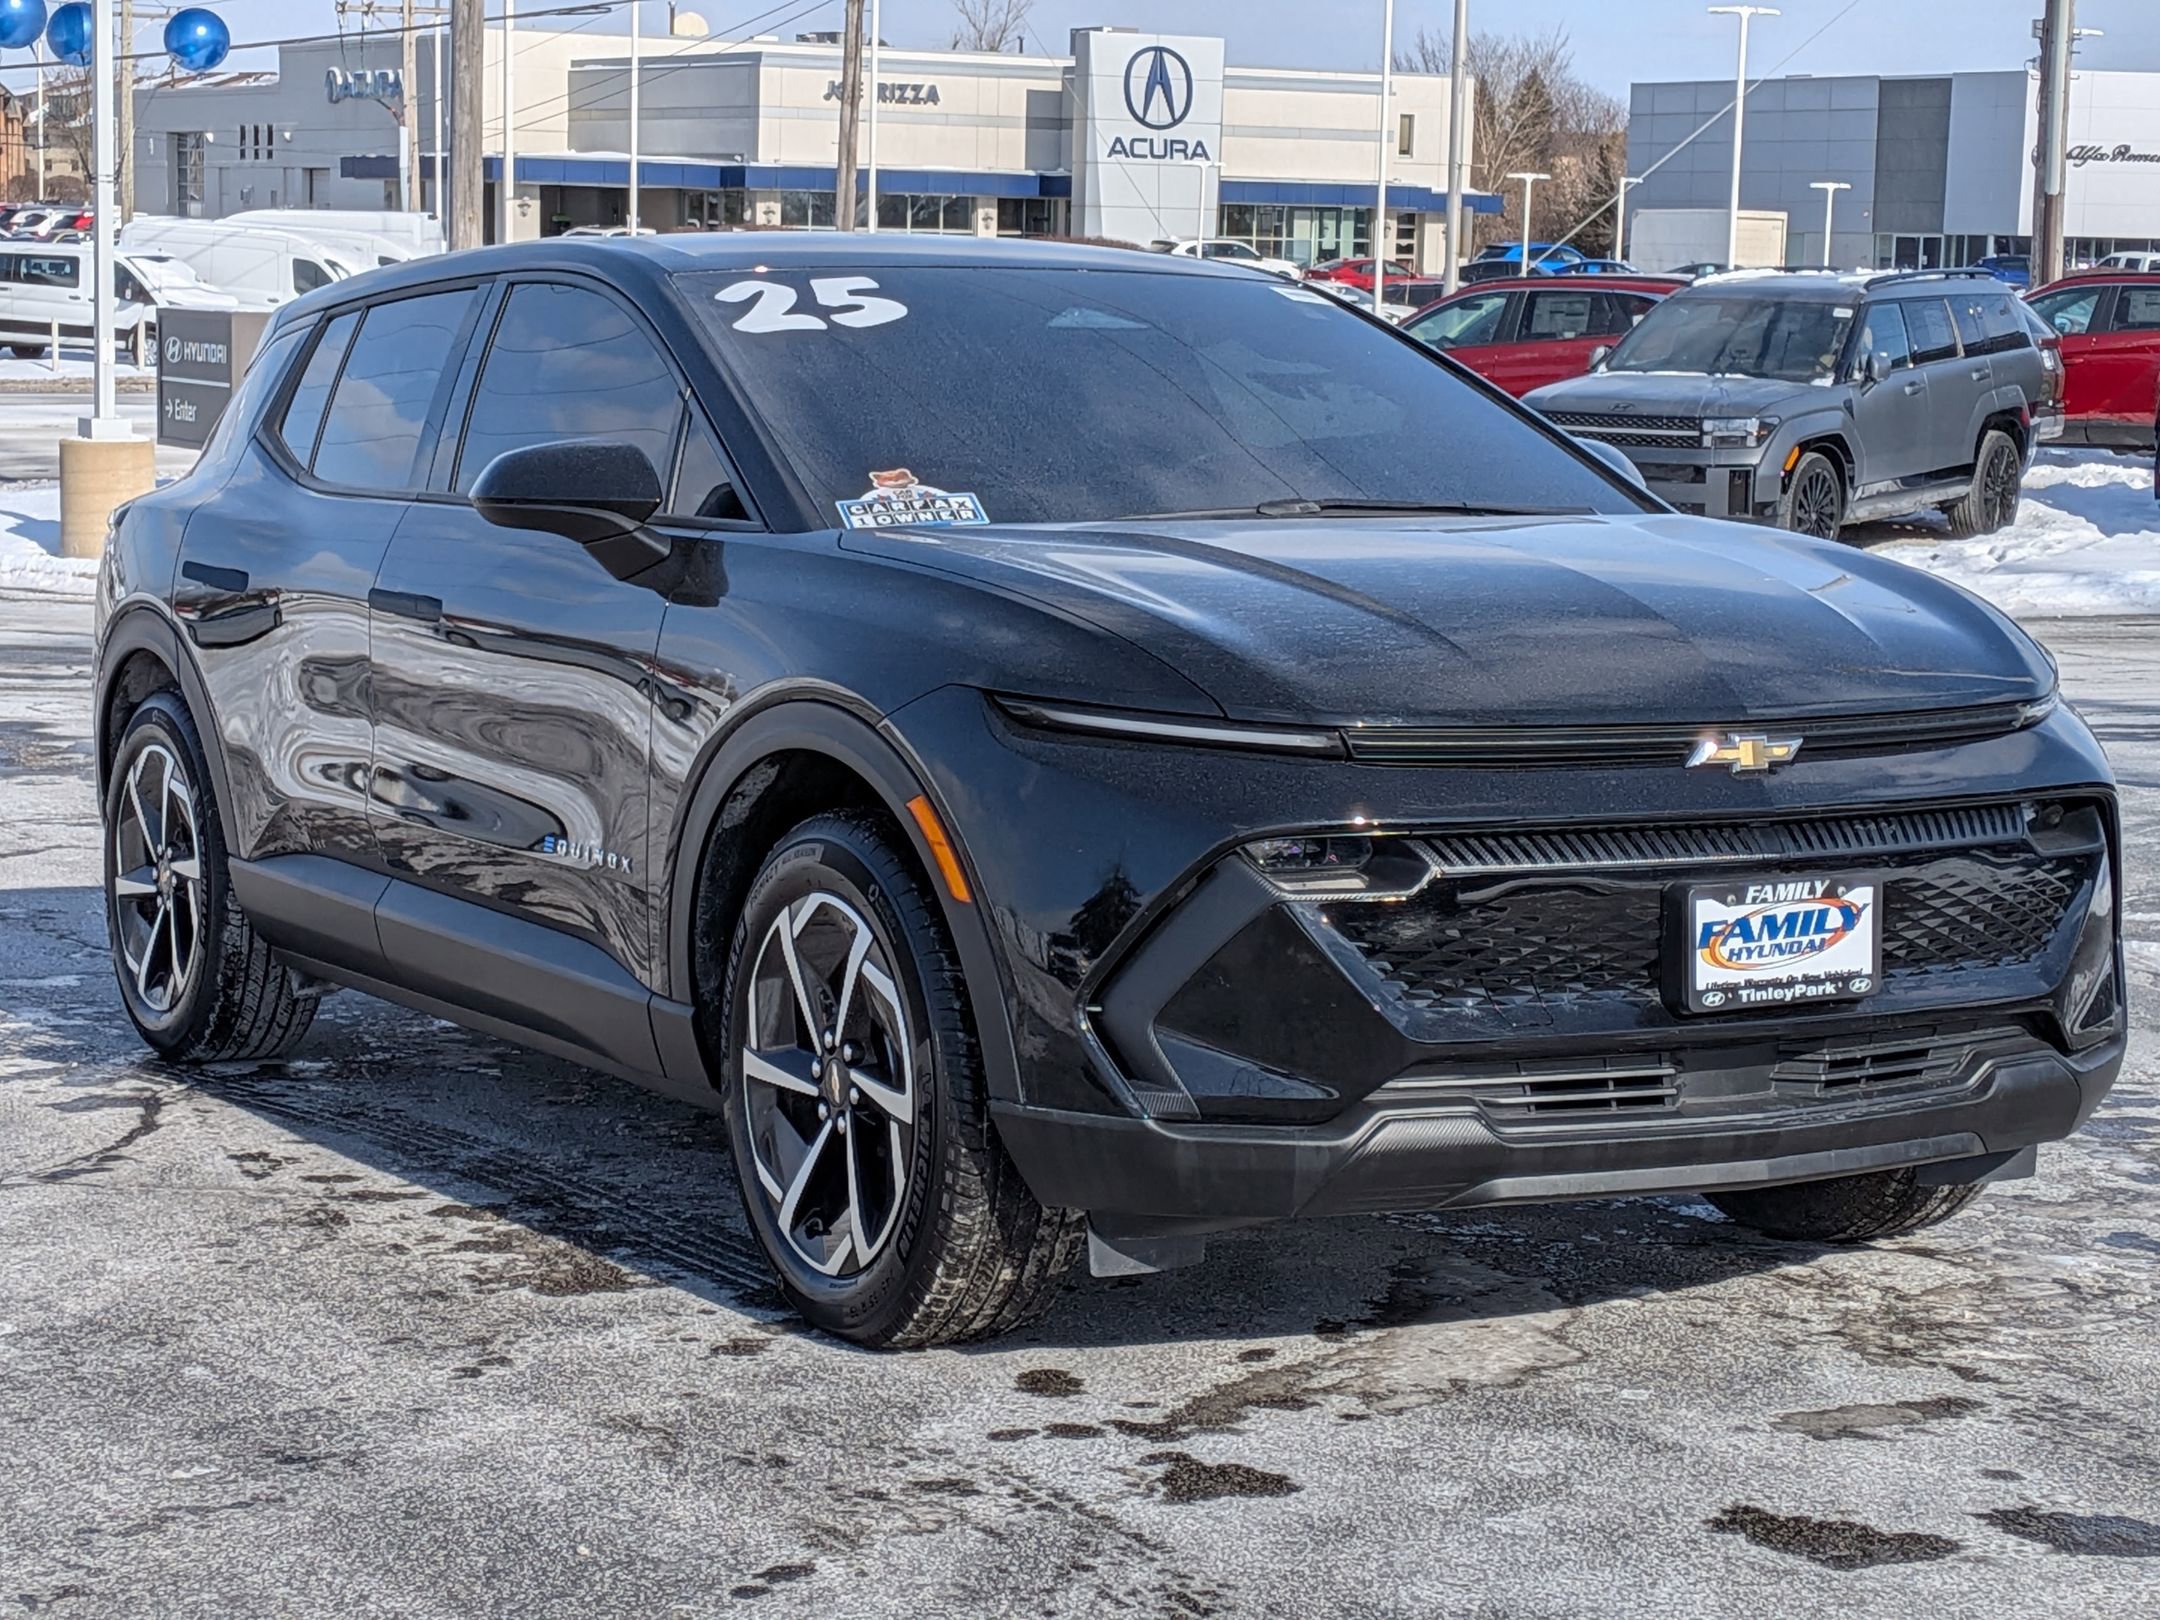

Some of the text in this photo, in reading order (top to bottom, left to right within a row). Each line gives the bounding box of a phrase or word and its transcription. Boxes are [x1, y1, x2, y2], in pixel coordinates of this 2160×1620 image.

[877, 82, 940, 105] RIZZA
[1107, 137, 1211, 161] ACURA
[2066, 145, 2109, 168] Alfa
[714, 276, 908, 333] 25
[184, 341, 227, 364] HYUNDAI
[175, 399, 197, 422] Enter
[850, 499, 968, 515] CARFAX
[876, 510, 975, 526] OWNER
[543, 835, 632, 874] EQUINOX
[1745, 880, 1830, 904] FAMILY
[1697, 903, 1870, 949] FAMILY
[1726, 937, 1827, 963] HYUNDAI
